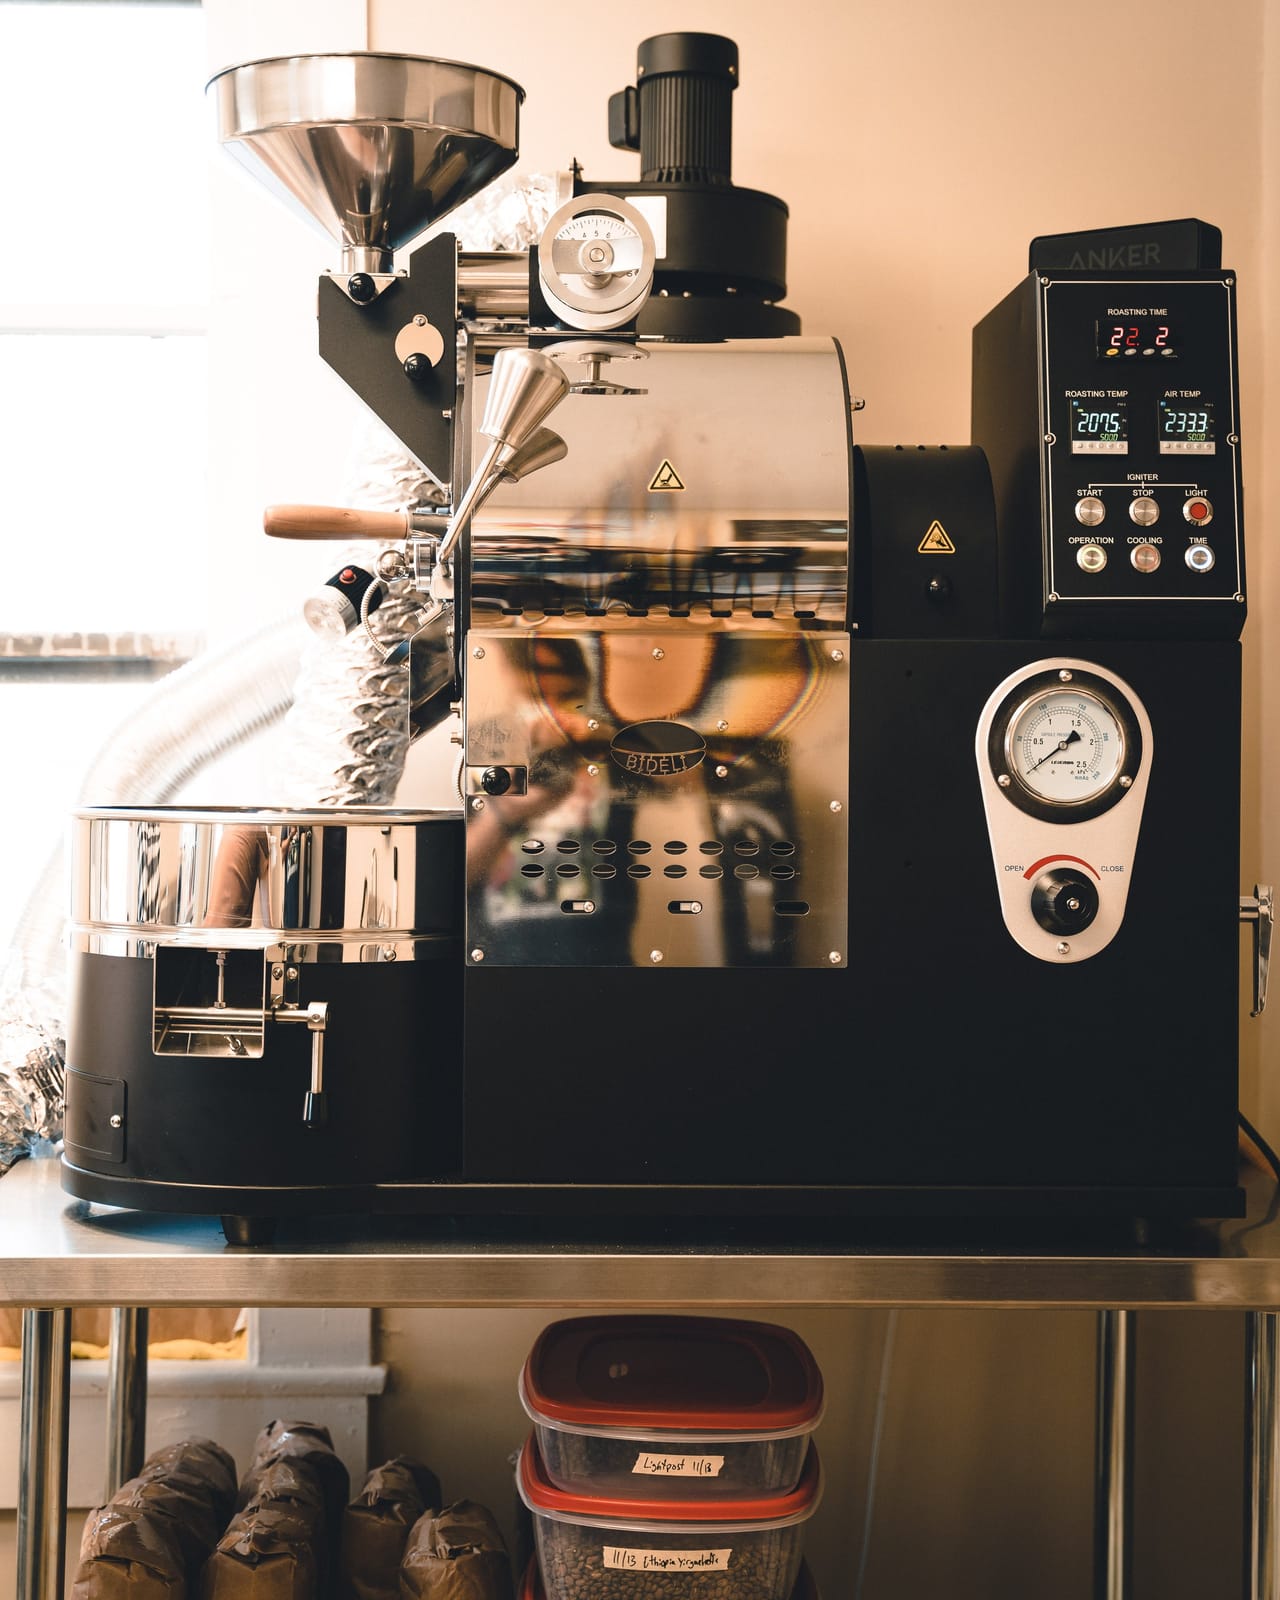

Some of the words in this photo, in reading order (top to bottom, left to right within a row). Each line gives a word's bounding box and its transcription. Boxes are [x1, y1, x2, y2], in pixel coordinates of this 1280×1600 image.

[1069, 242, 1161, 270] ANKER
[1107, 308, 1147, 316] ROASTING
[1149, 308, 1168, 316] TIME
[1065, 390, 1105, 398] ROASTING
[1107, 390, 1129, 398] TEMP
[1164, 390, 1178, 398] AIR
[1179, 390, 1201, 398] TEMP
[1127, 473, 1159, 481] IGNITER
[1077, 489, 1103, 497] START
[1132, 489, 1154, 497] STOP
[1185, 489, 1208, 497] LIGHT
[1071, 719, 1082, 727] 1.5
[1033, 737, 1044, 745] 0.5
[625, 754, 688, 773] BIDELI
[1076, 760, 1087, 768] 2.5
[643, 1456, 685, 1473] Lightpost
[613, 1549, 637, 1567] 11/13
